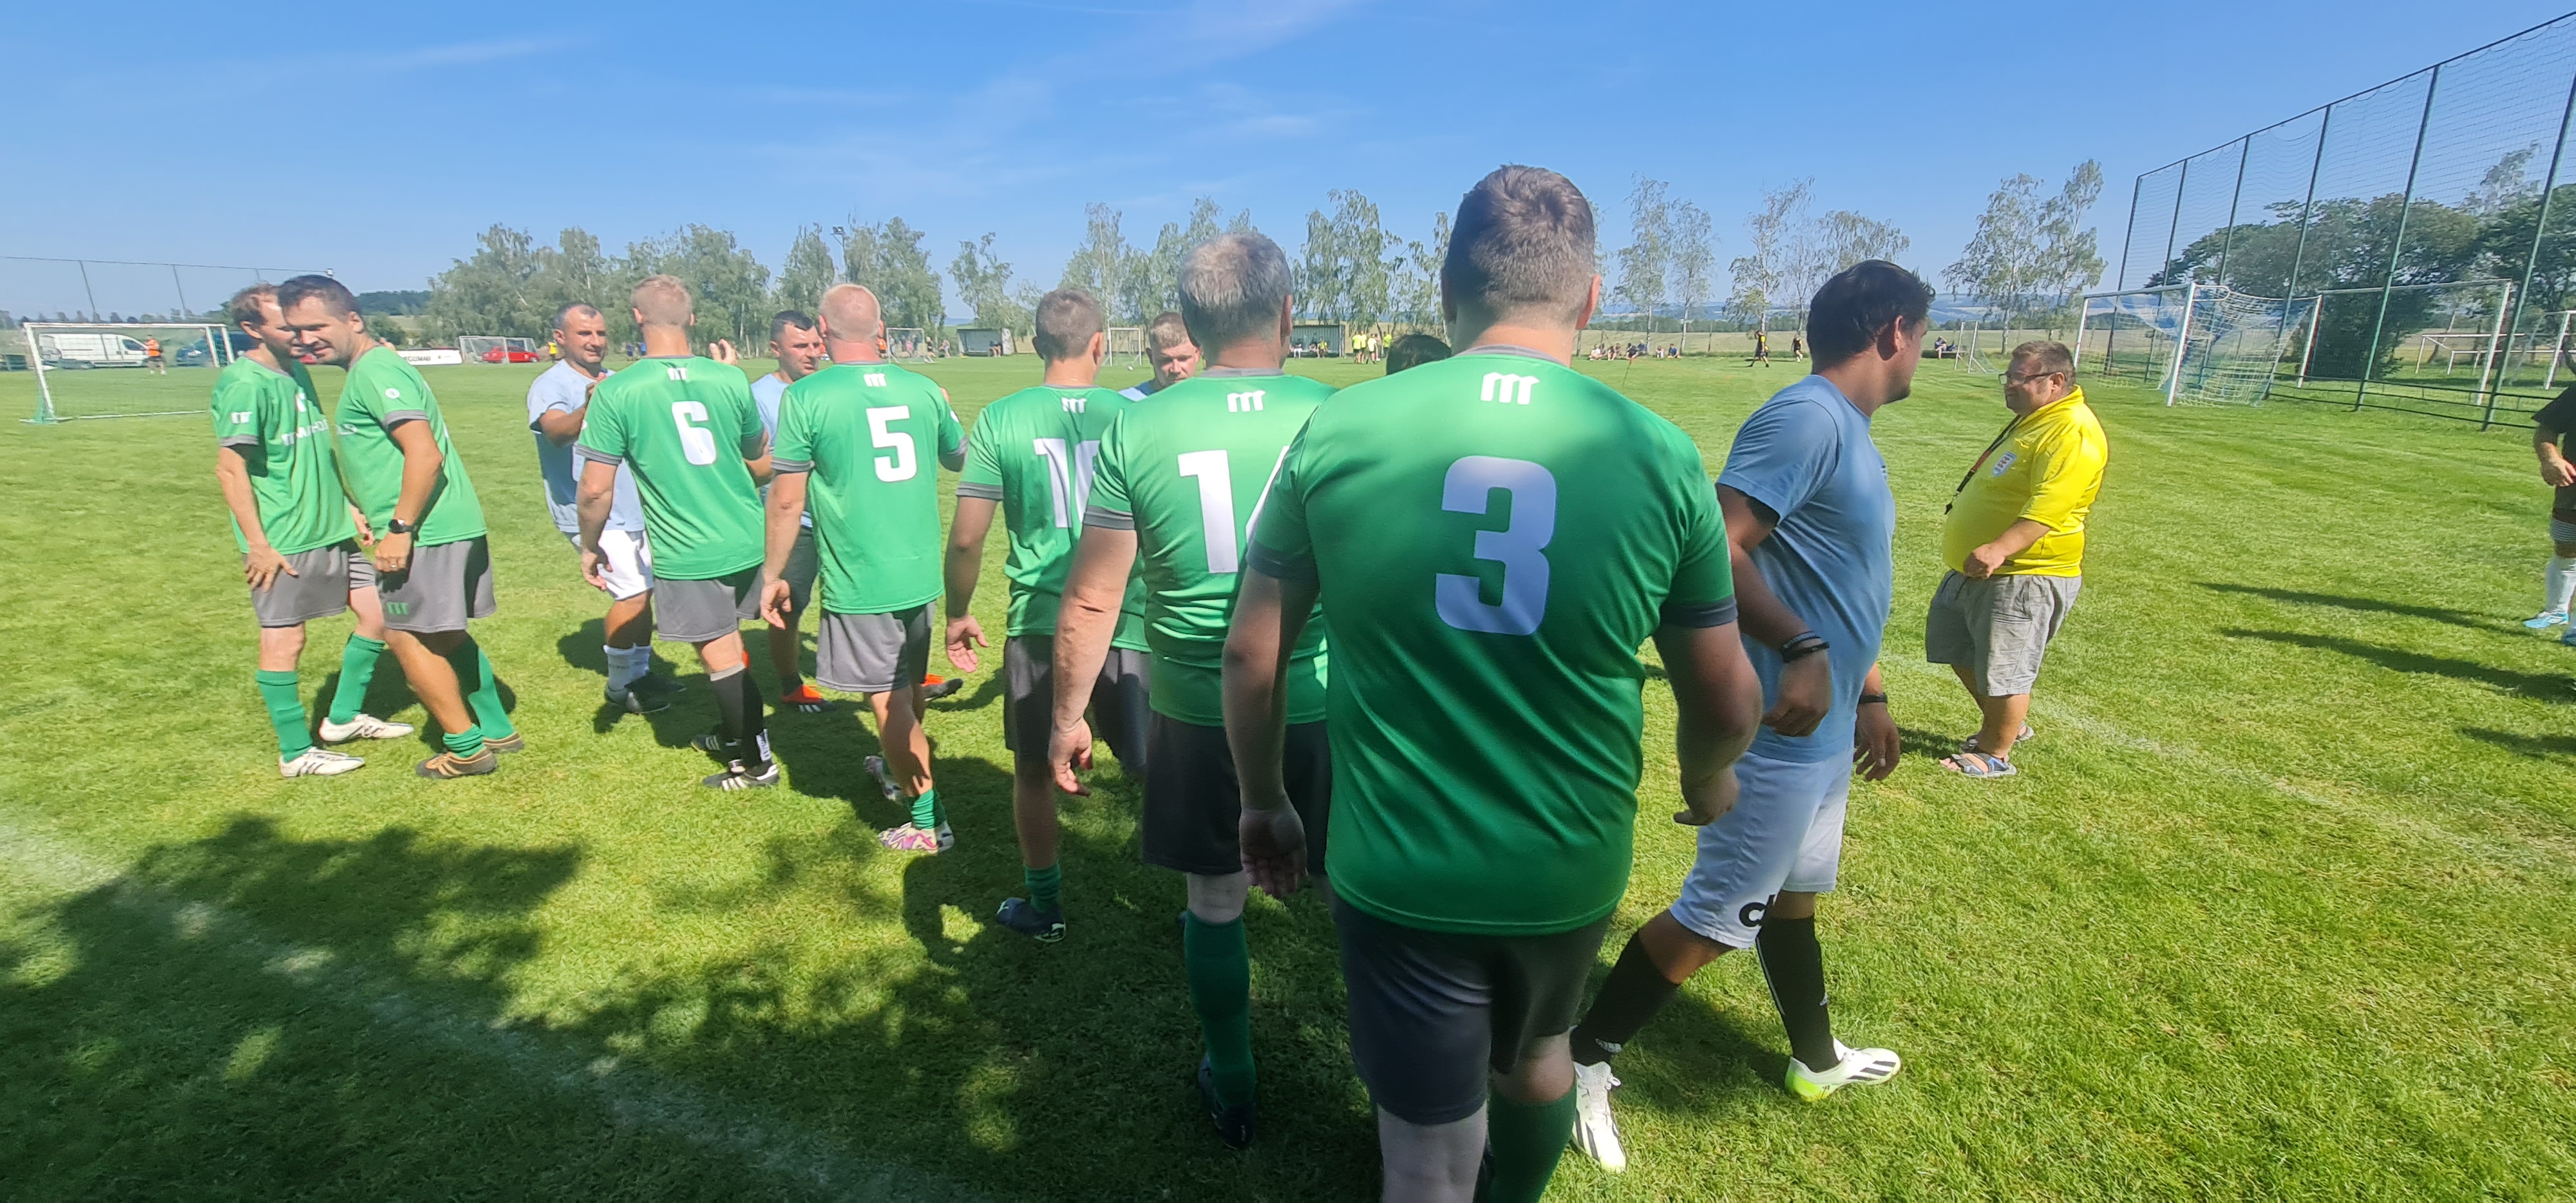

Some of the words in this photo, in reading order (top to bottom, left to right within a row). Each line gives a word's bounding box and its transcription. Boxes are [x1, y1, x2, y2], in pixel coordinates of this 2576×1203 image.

[671, 401, 717, 466] 6
[866, 405, 917, 482] 5
[1177, 445, 1290, 573] 1
[1435, 455, 1557, 636] 3
